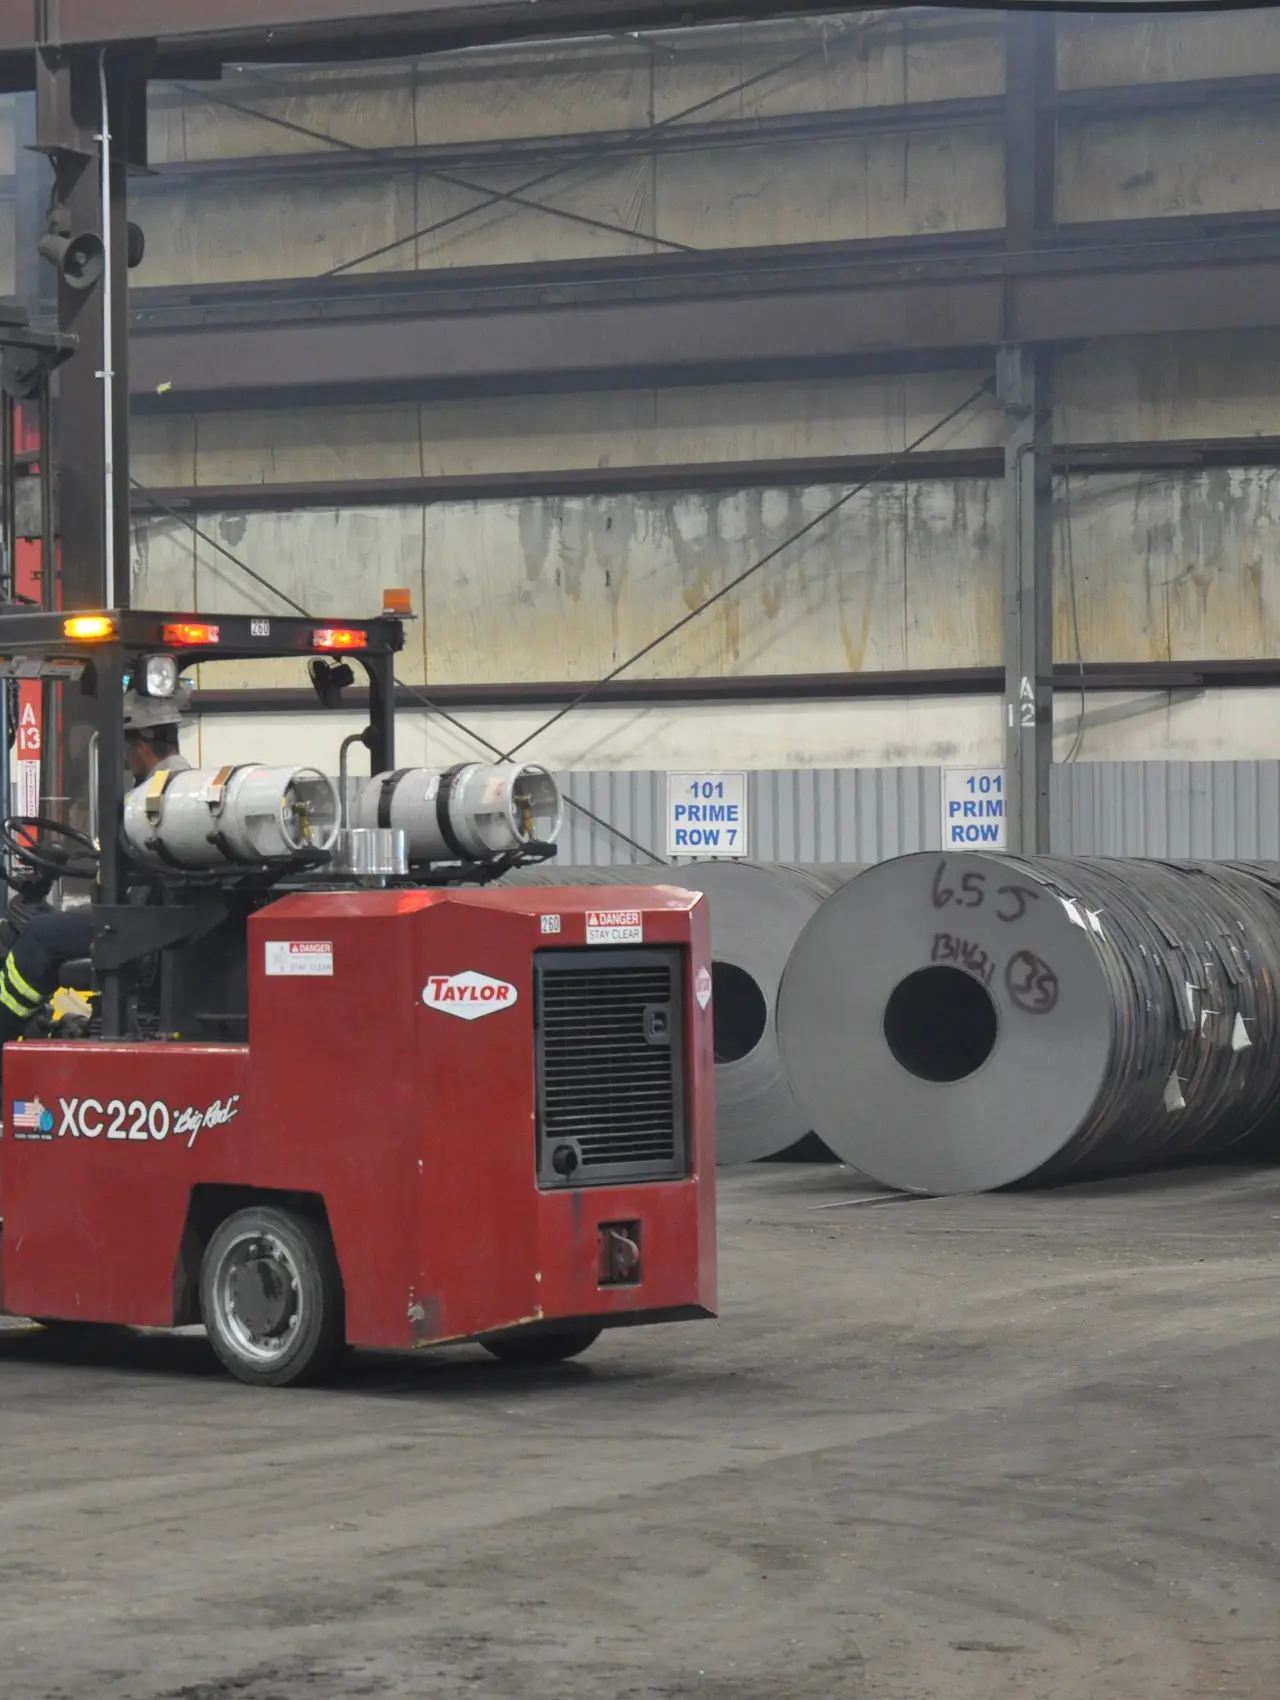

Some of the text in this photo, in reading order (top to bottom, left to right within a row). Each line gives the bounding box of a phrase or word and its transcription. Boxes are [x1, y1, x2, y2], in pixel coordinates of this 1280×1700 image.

[1020, 676, 1034, 700] A
[22, 703, 36, 725] A
[20, 727, 40, 749] 13
[690, 781, 723, 798] 101
[966, 775, 1002, 793] 101
[674, 804, 738, 821] PRIME
[948, 800, 1007, 817] PRIM
[675, 828, 737, 846] ROW 7
[951, 824, 999, 842] ROW
[932, 860, 986, 909] 6.5
[542, 917, 559, 931] 260
[599, 913, 639, 925] DANGER
[589, 929, 640, 940] STAY CLEAR
[300, 944, 331, 952] DANGER
[430, 978, 510, 1001] TAYLOR
[58, 1098, 169, 1140] XC220
